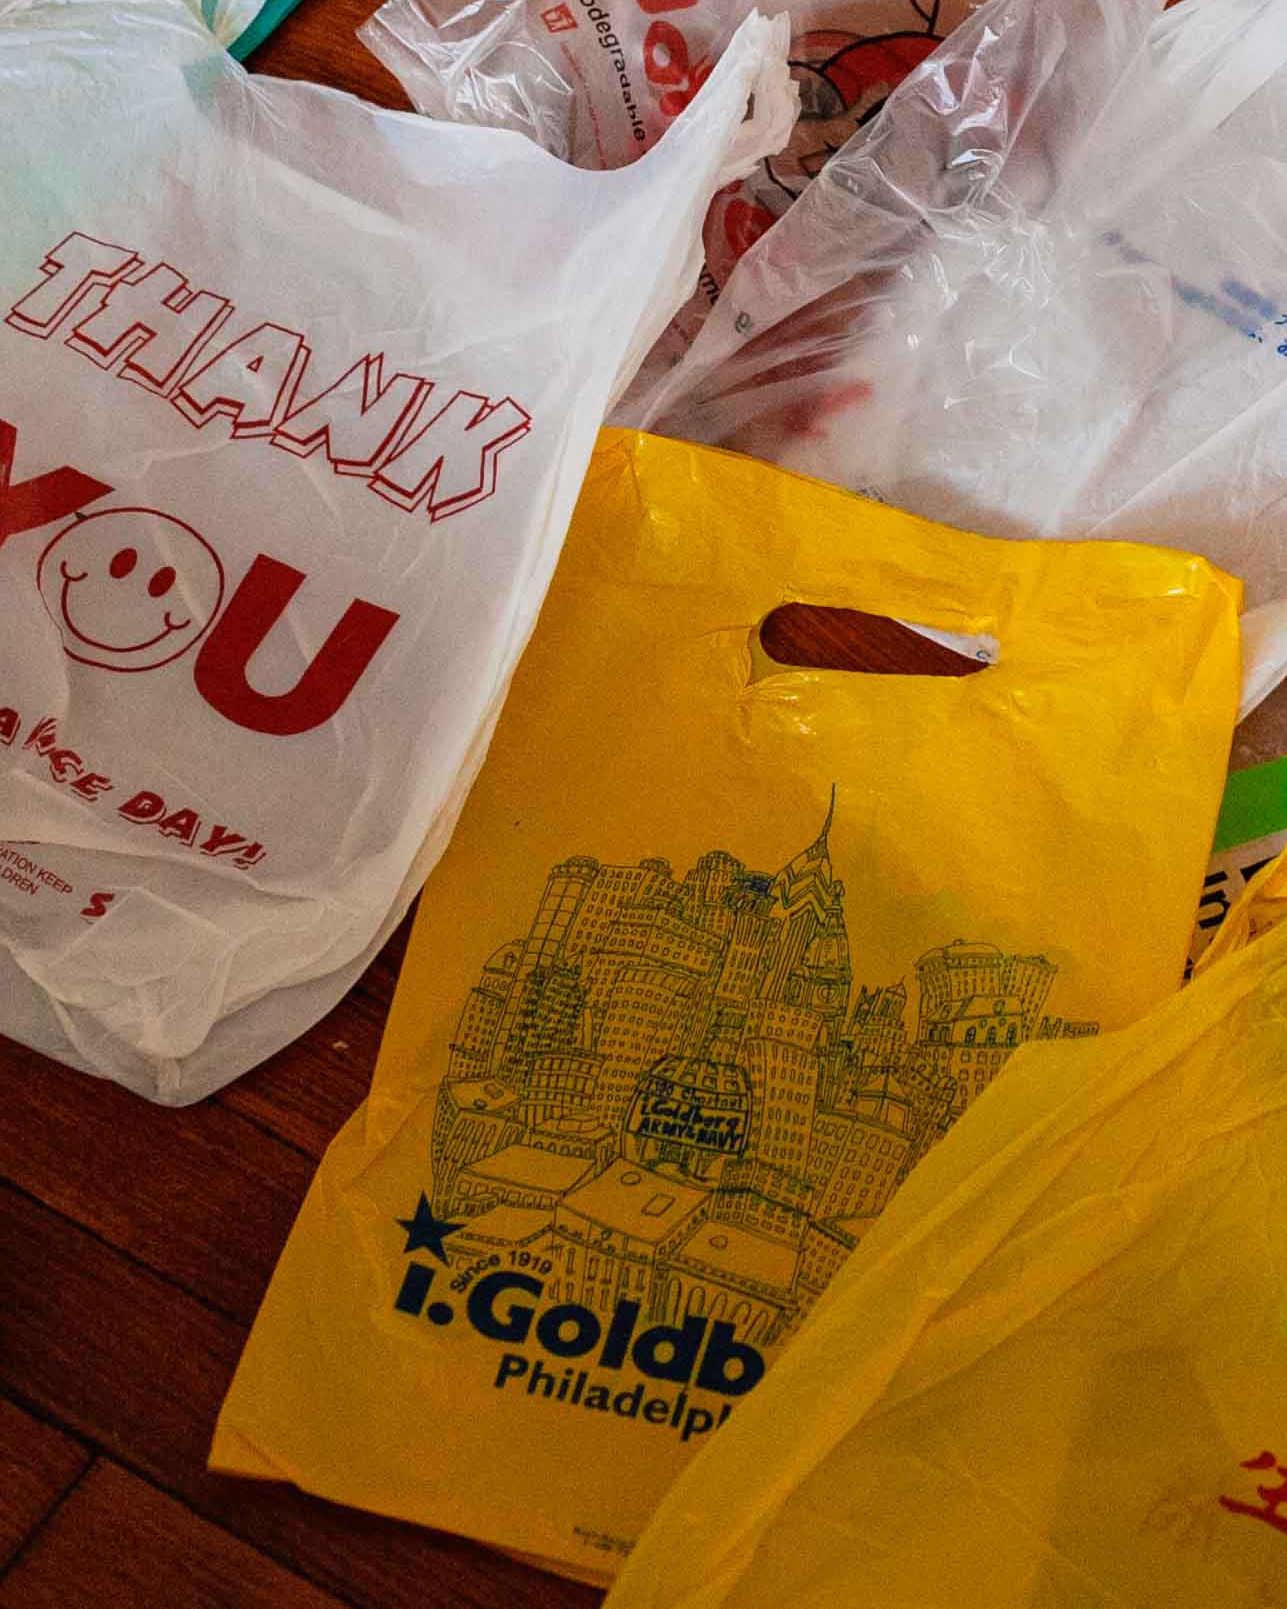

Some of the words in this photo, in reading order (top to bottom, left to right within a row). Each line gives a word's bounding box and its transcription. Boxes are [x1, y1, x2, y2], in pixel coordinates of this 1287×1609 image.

[4, 231, 532, 523] THANK
[23, 717, 114, 802] NCE
[117, 790, 266, 870] DAY!
[0, 864, 39, 896] DREN
[36, 867, 74, 895] KEEP
[450, 1250, 501, 1295] Since
[507, 1249, 554, 1277] 1919
